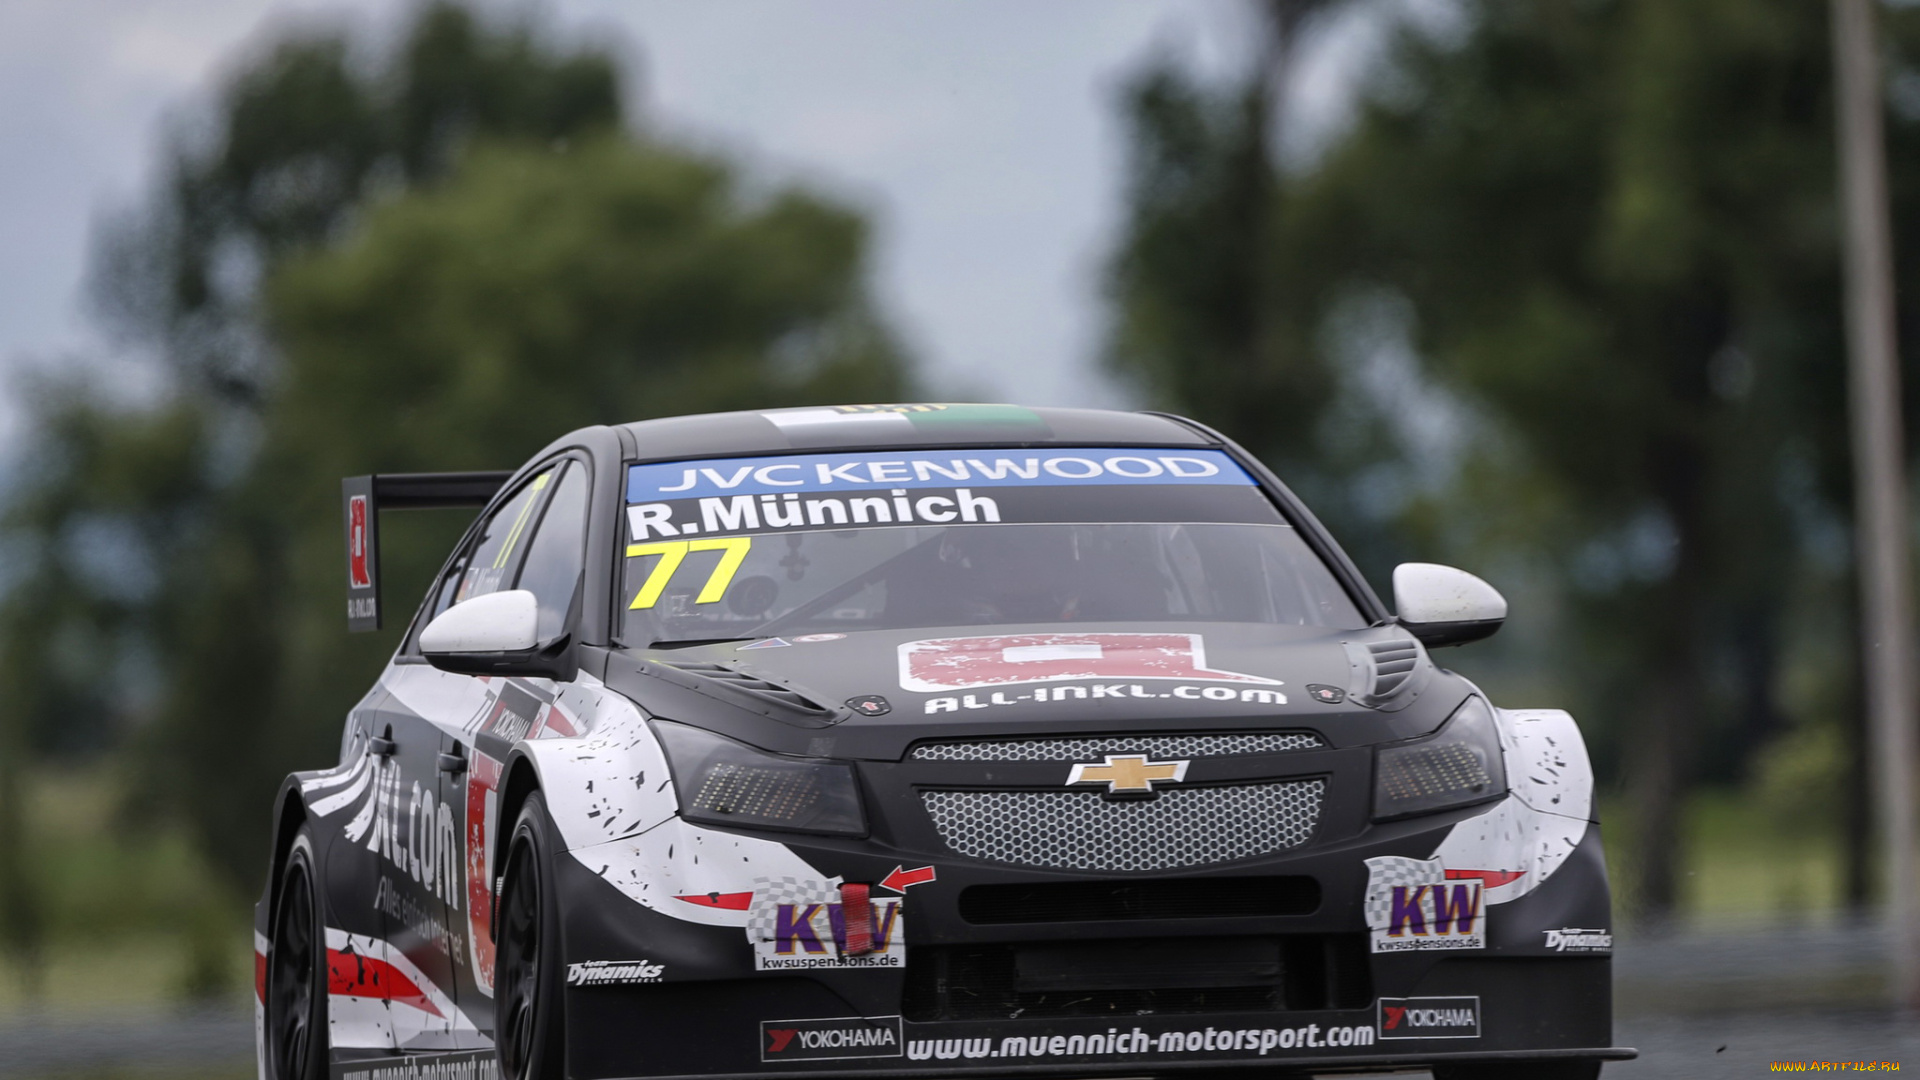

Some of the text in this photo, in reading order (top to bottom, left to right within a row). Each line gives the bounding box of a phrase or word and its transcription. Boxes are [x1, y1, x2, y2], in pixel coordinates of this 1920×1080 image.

[815, 457, 1220, 485] KENWOOD
[626, 488, 1002, 541] R.Münnich
[626, 537, 752, 611] 77
[1387, 883, 1483, 937] KW
[567, 959, 665, 986] Dynamics
[1405, 1008, 1477, 1028] YOKOHAMA
[797, 1027, 896, 1049] YOKOHAMA
[907, 1023, 1375, 1061] www.muennich-motorsport.com
